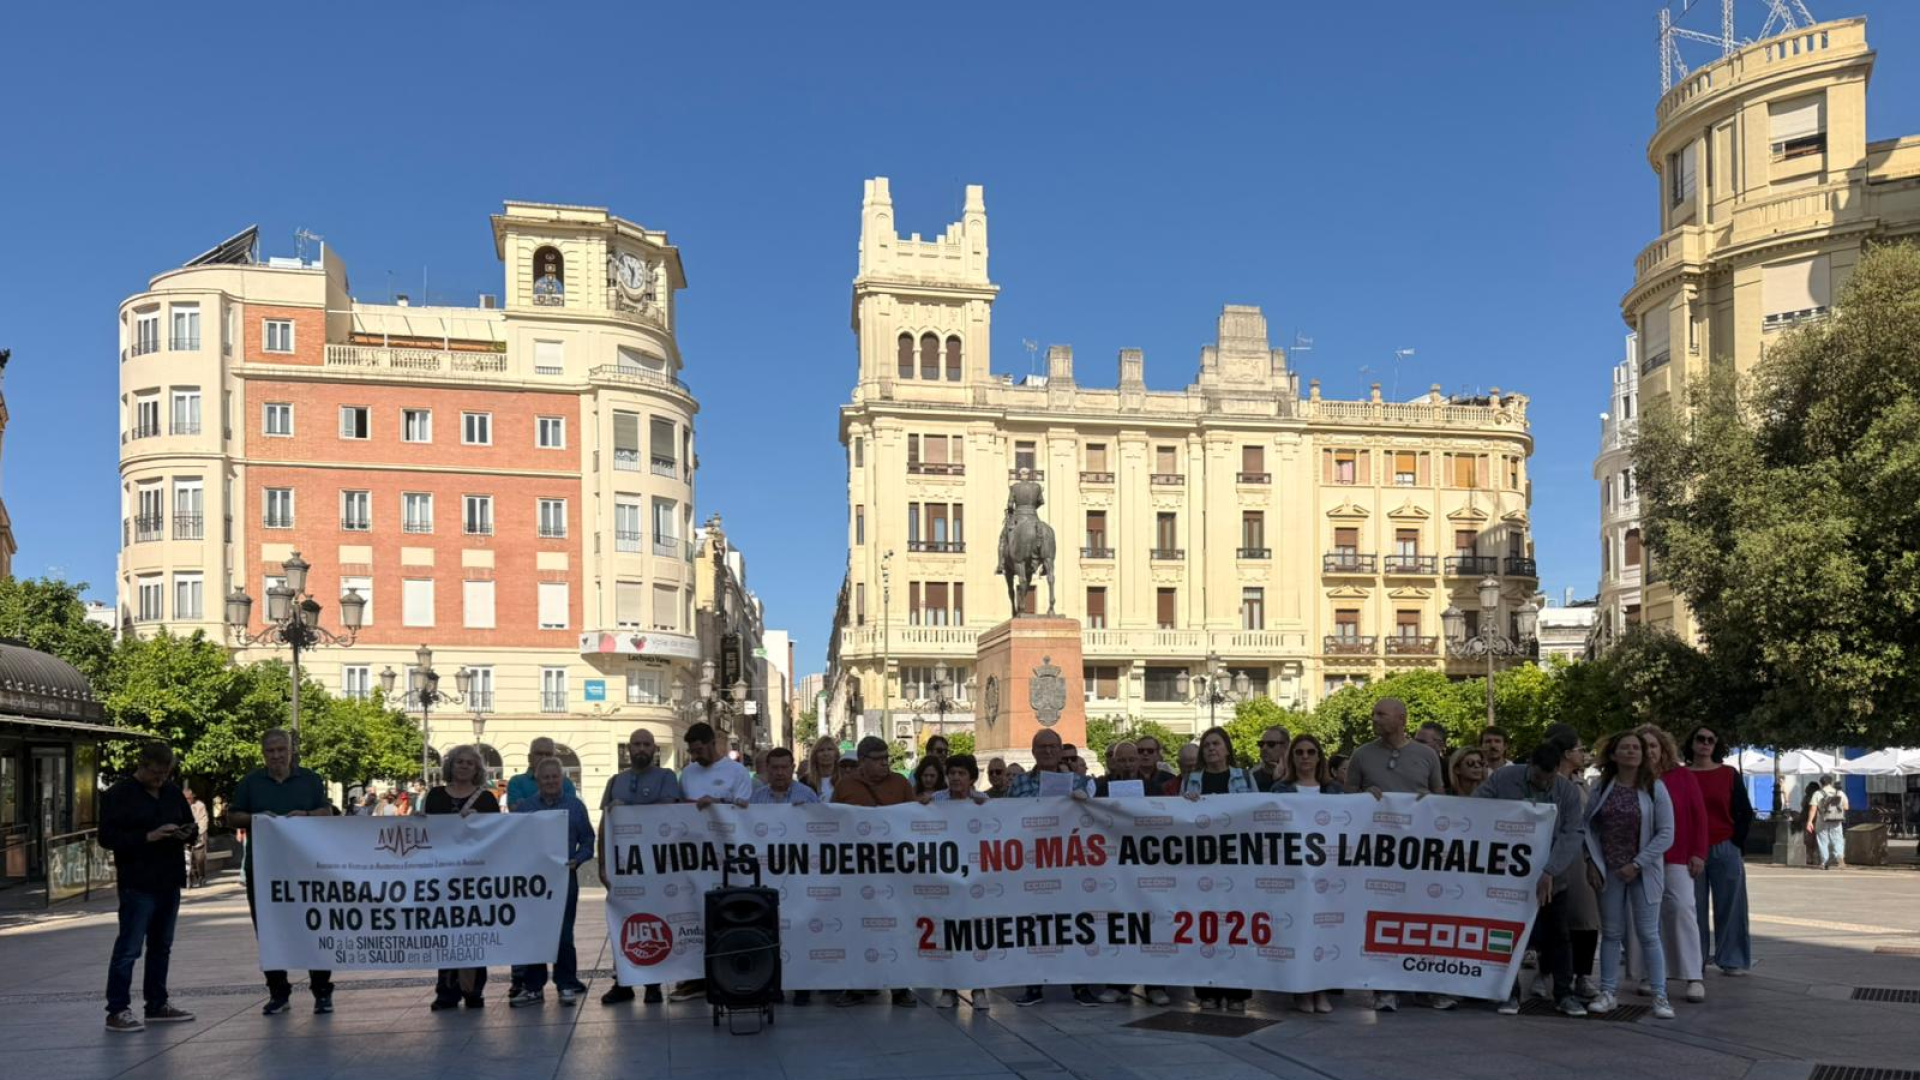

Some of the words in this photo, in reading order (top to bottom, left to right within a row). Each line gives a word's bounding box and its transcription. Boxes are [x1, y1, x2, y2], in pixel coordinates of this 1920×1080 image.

[614, 844, 644, 876] LA
[651, 841, 719, 875] VIDA
[723, 842, 757, 875] ES
[767, 842, 809, 875] UN
[819, 840, 969, 878] DERECHO,
[979, 838, 1024, 872] NO
[1035, 828, 1107, 869] MÁS
[1119, 833, 1327, 867] ACCIDENTES
[1337, 834, 1532, 877] LABORALES
[271, 880, 294, 903] EL
[300, 878, 407, 902] TRABAJO
[414, 878, 440, 901] ES
[448, 874, 553, 901] SEGURO,
[306, 907, 321, 931] O
[330, 907, 363, 931] NO
[371, 906, 396, 930] ES
[401, 903, 516, 929] TRABAJO
[318, 936, 334, 950] NO
[356, 935, 448, 950] SINIESTRALIDAD
[451, 931, 503, 948] LABORAL
[627, 922, 664, 943] UGT
[915, 916, 937, 950] 2
[944, 913, 1095, 951] MUERTES
[1108, 912, 1152, 945] EN
[1173, 910, 1272, 946] 2026
[369, 949, 405, 963] SALUD
[408, 952, 420, 963] en
[422, 952, 432, 963] el
[436, 947, 485, 962] TRABAJO
[1402, 957, 1483, 978] Córdoba
